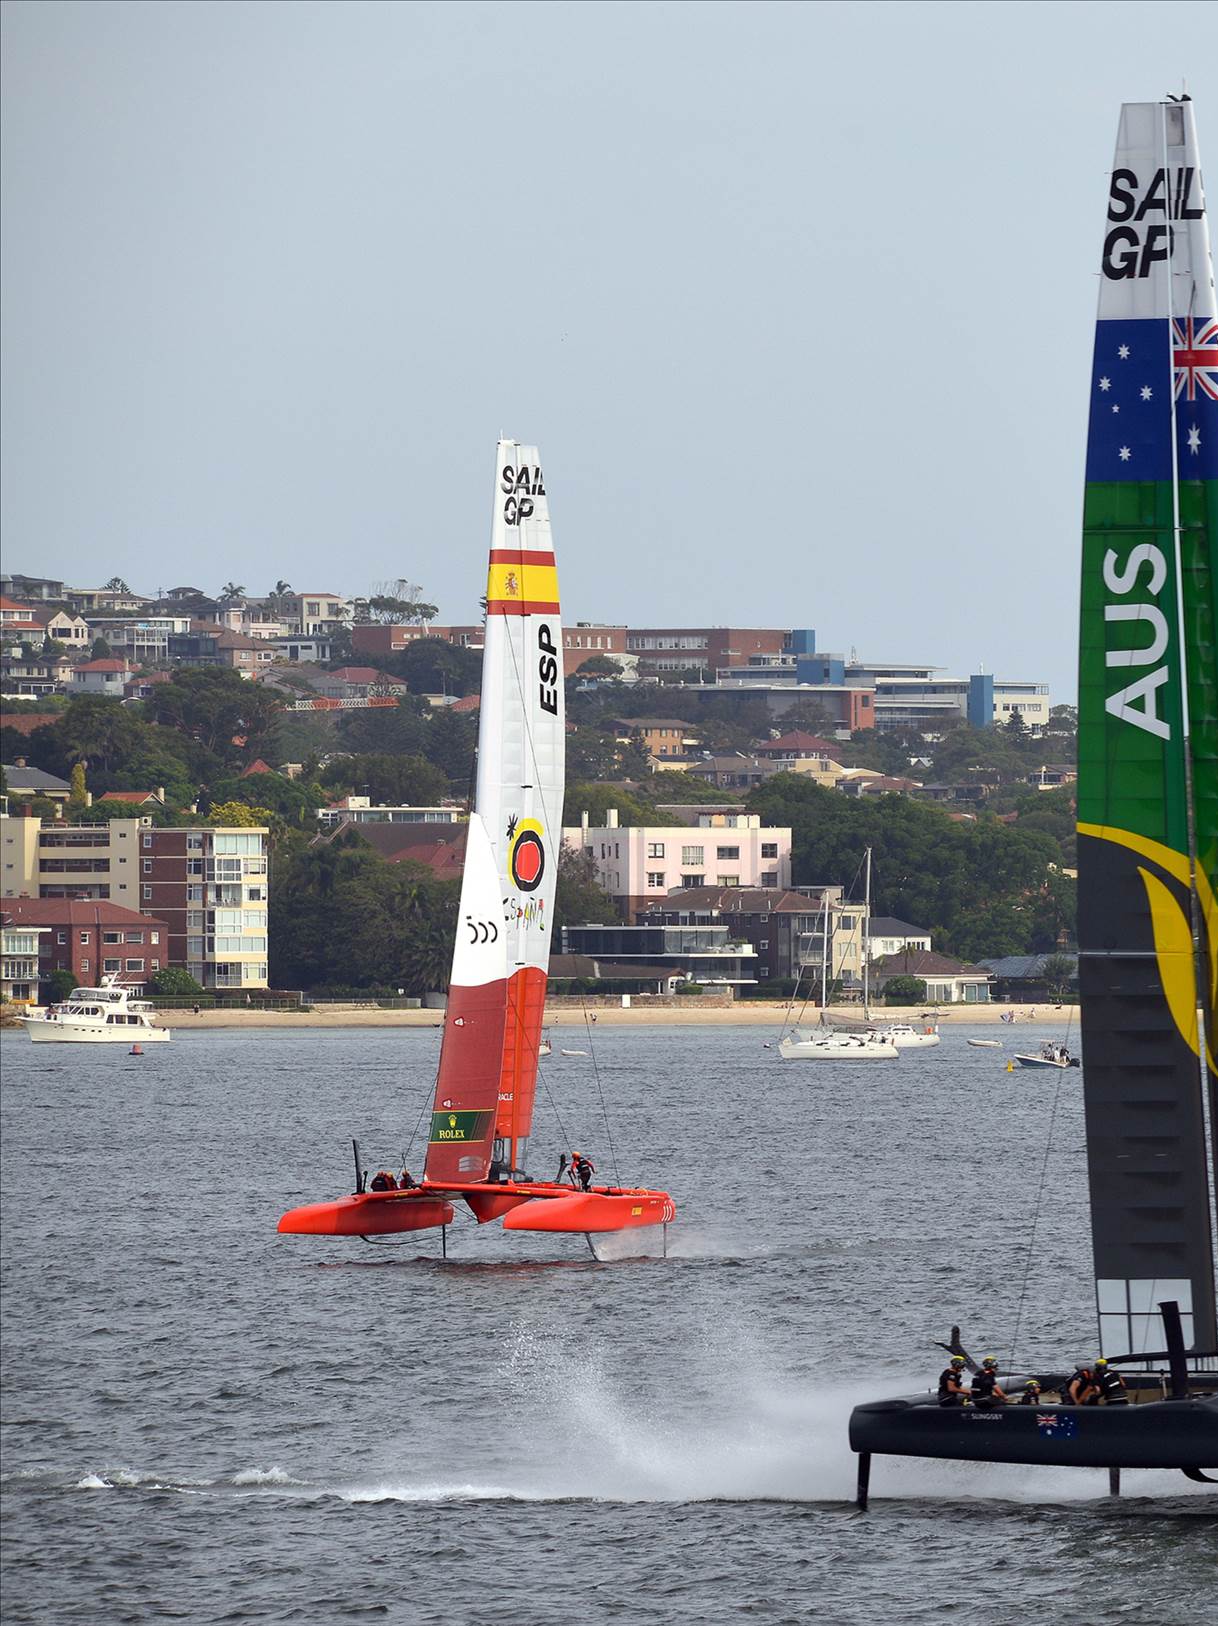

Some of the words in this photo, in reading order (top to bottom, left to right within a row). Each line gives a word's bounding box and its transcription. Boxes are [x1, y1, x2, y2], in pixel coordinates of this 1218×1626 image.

[1106, 167, 1206, 222] SAIL
[1101, 225, 1175, 280] GP
[500, 465, 546, 495] SAIL
[504, 496, 534, 526] GP
[538, 623, 558, 716] ESP
[1103, 543, 1171, 741] AUS
[438, 1129, 465, 1139] ROLEX
